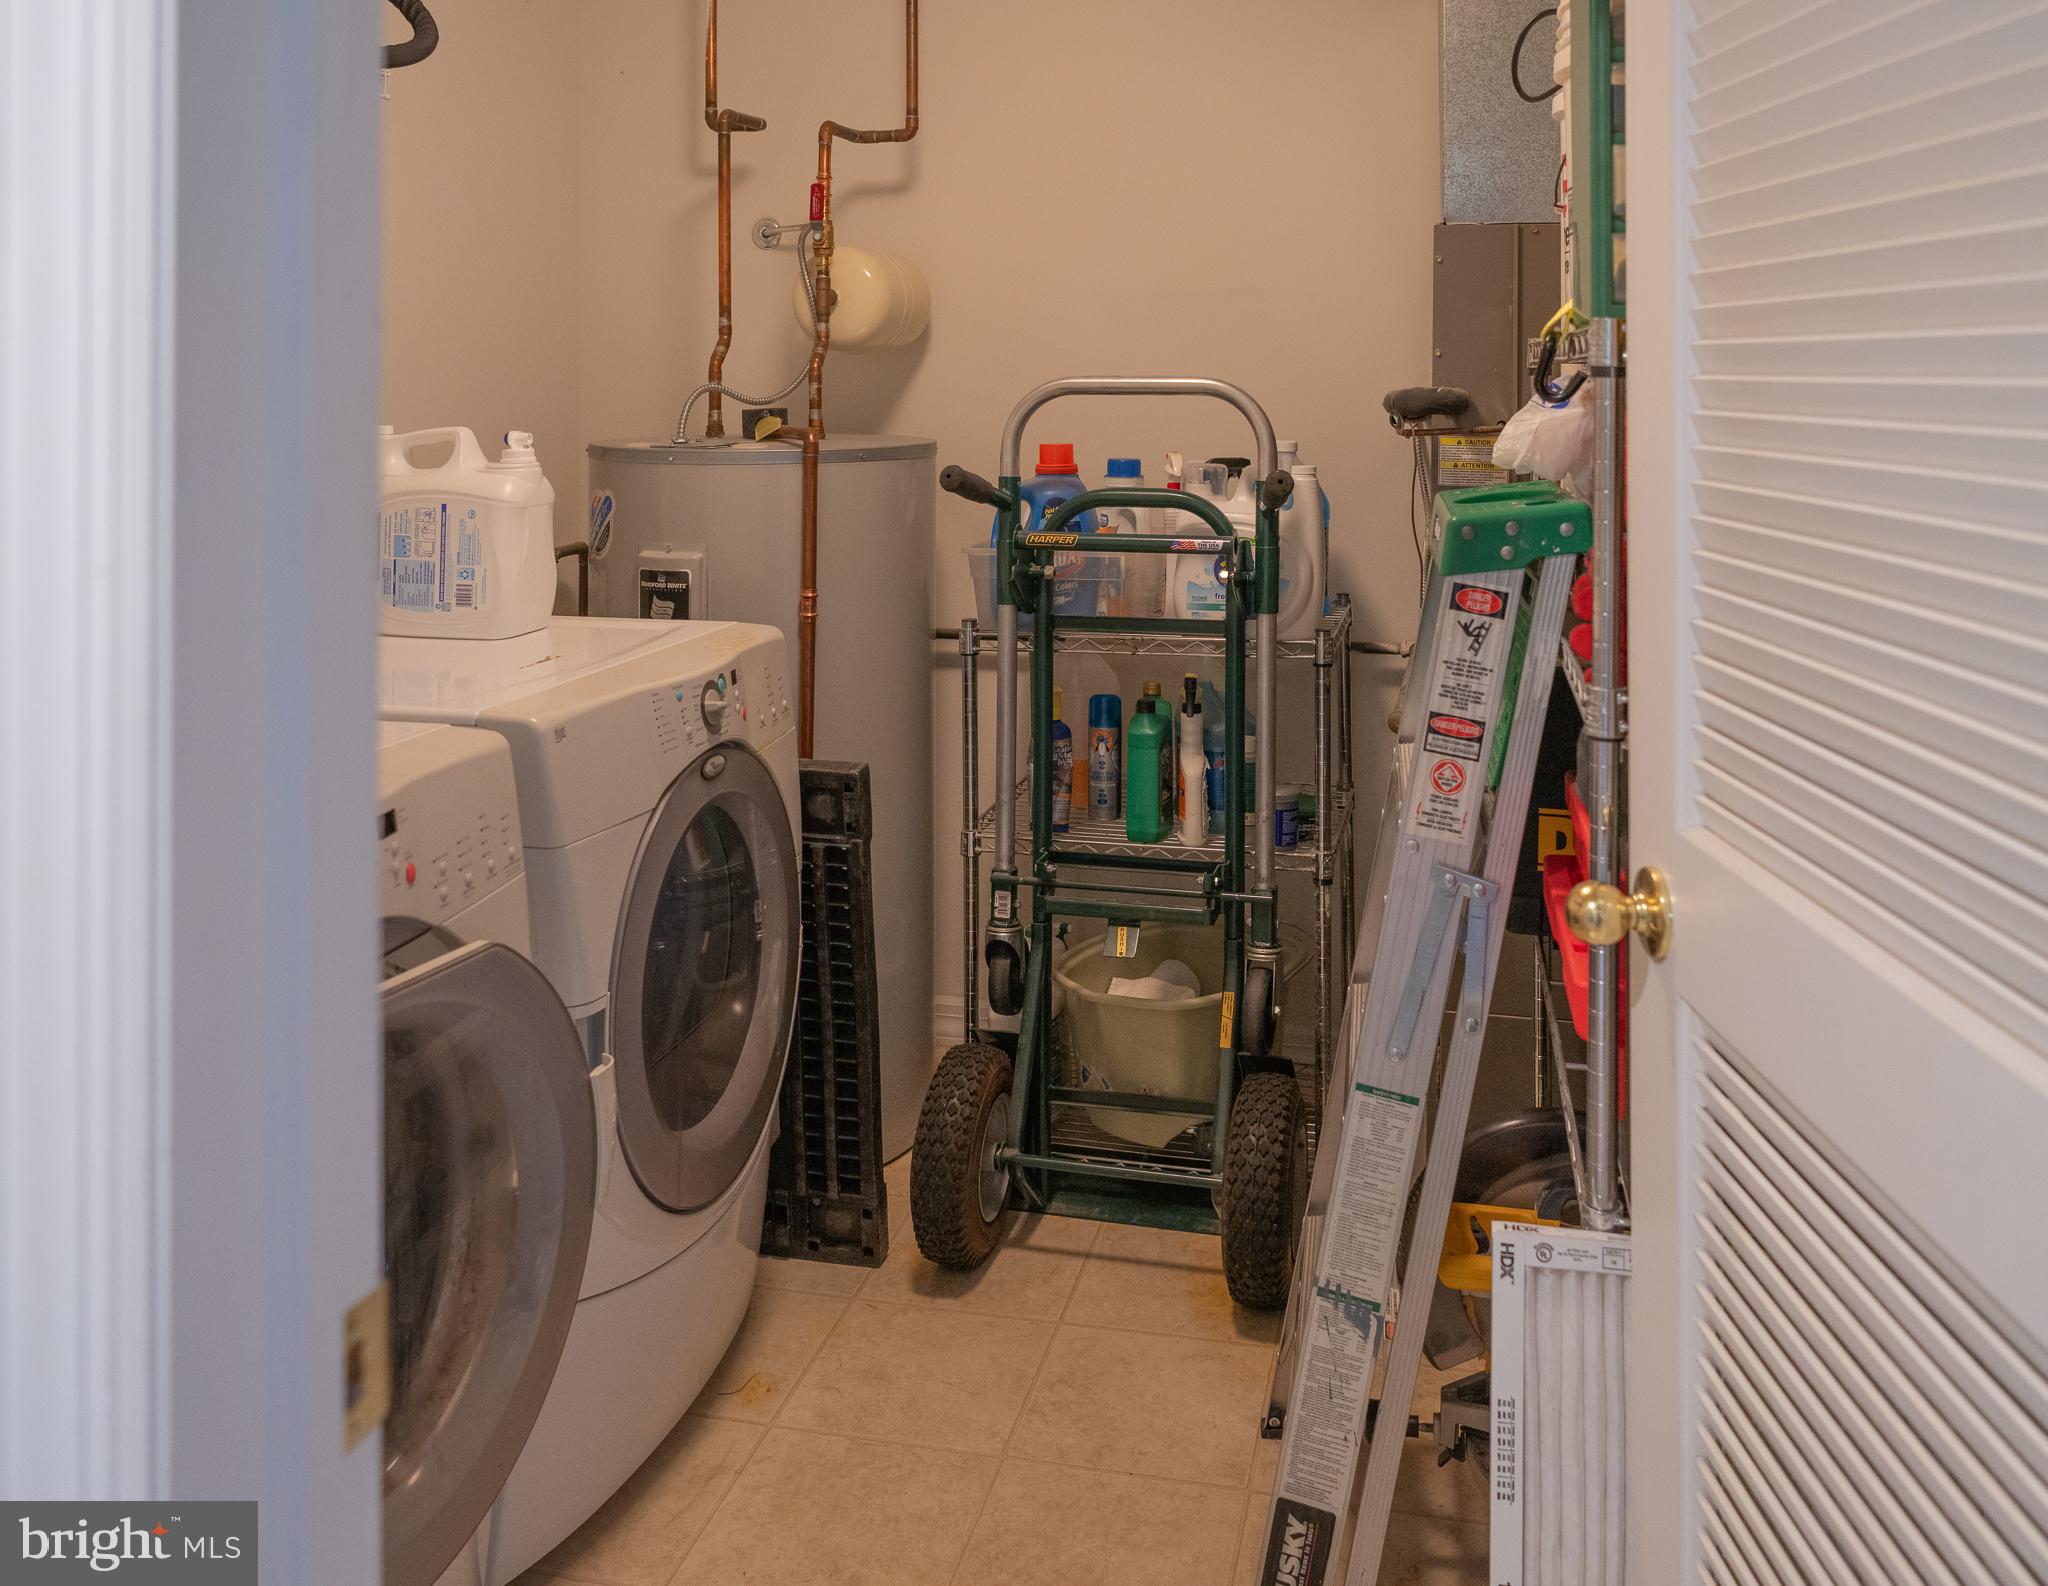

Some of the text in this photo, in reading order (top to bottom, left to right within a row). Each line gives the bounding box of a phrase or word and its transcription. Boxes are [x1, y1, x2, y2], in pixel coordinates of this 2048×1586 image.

[1029, 535, 1074, 544] HARPER
[641, 580, 667, 589] BRADFORD
[1503, 1223, 1540, 1234] HDX
[1499, 1242, 1515, 1281] HDX
